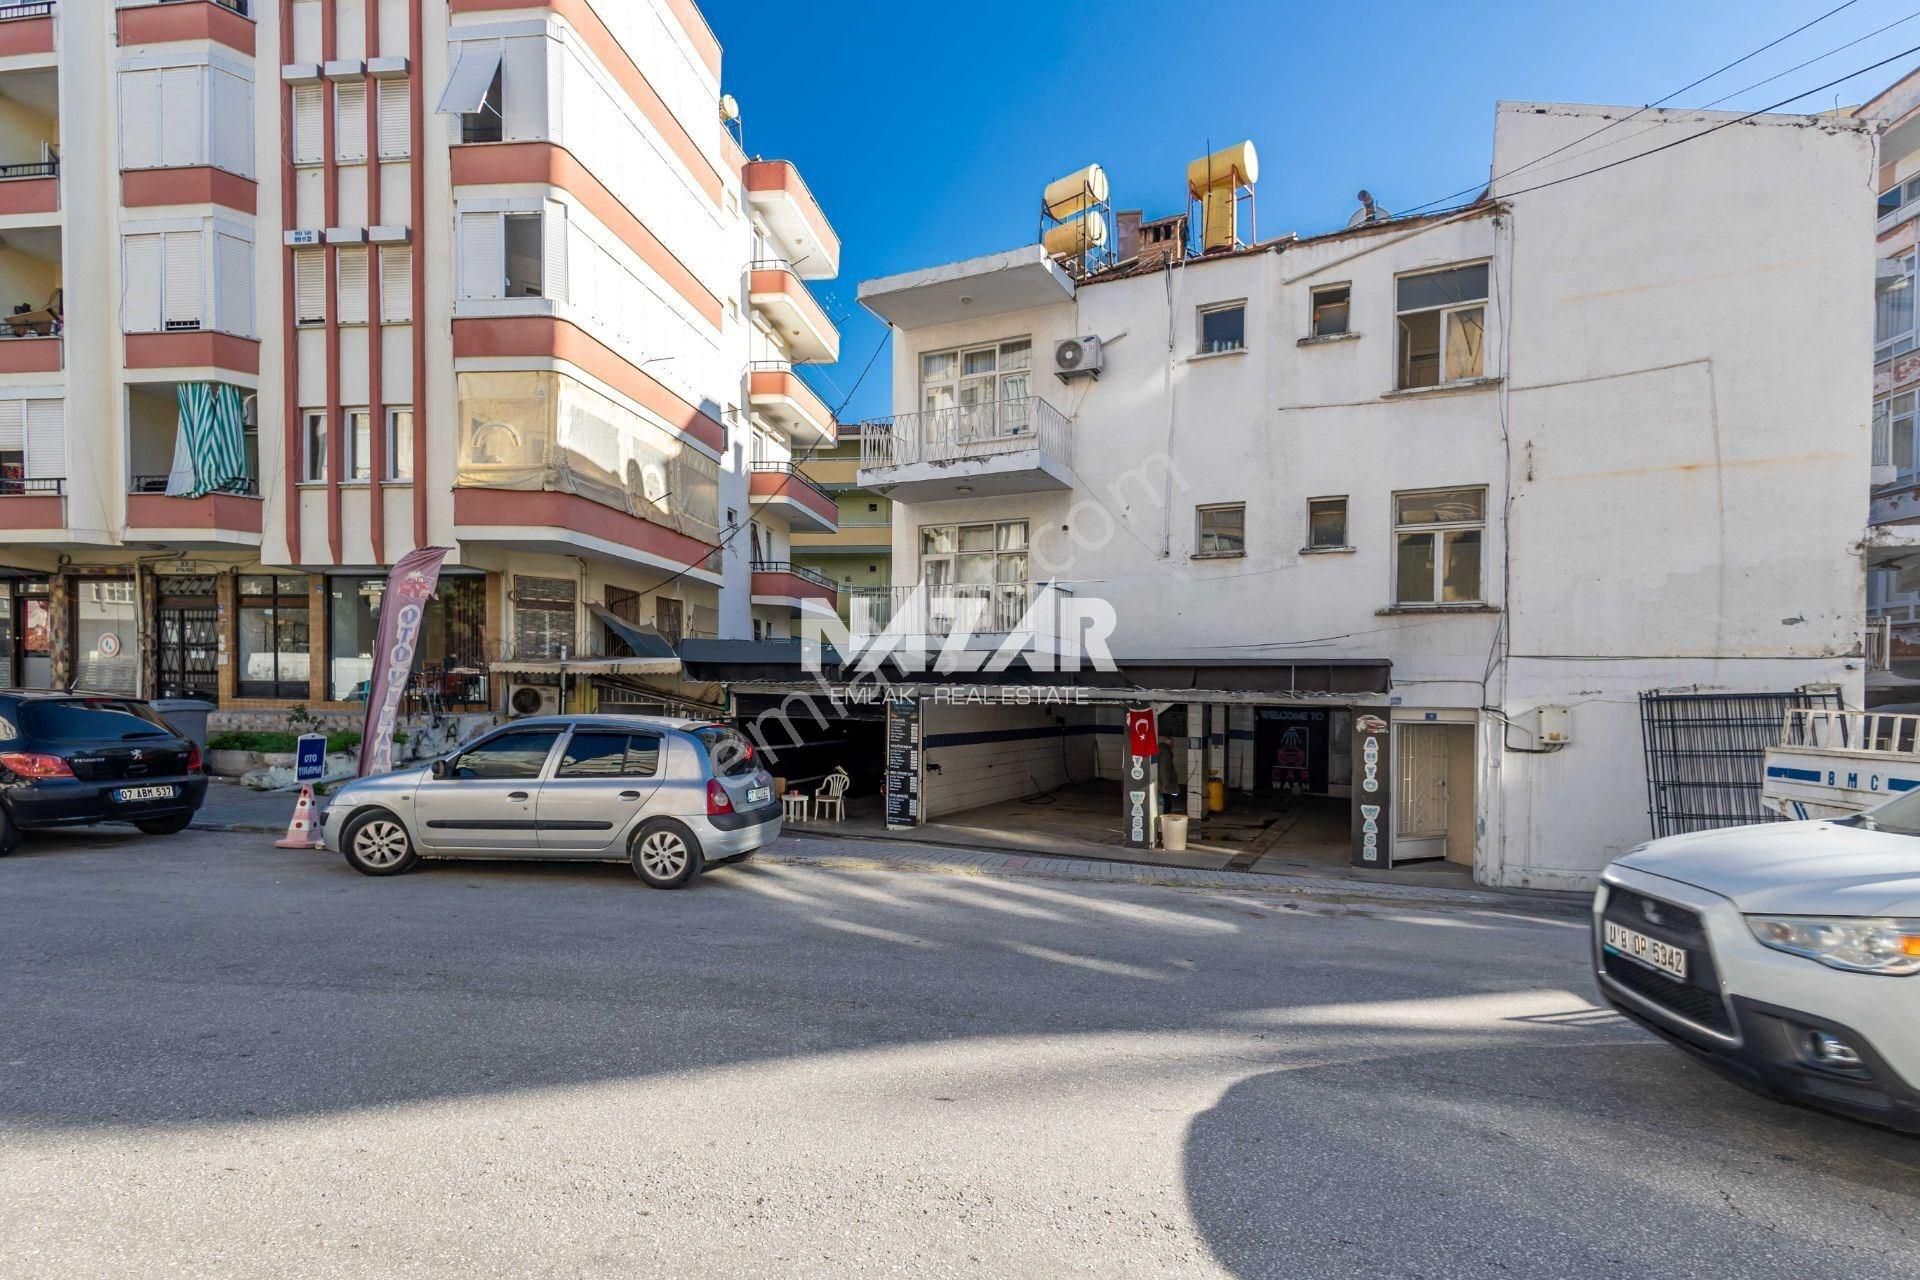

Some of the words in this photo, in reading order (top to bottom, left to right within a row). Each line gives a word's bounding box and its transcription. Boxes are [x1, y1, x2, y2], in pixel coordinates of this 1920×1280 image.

[1260, 710, 1309, 721] WELCOME
[1311, 711, 1324, 721] TO
[304, 754, 318, 763] OTO
[1363, 736, 1379, 792] AUTO
[1271, 780, 1311, 791] WASH
[121, 790, 133, 799] 07
[137, 788, 154, 798] ABM
[156, 786, 171, 797] 537
[1361, 804, 1381, 861] WASH
[1652, 942, 1684, 973] 5342
